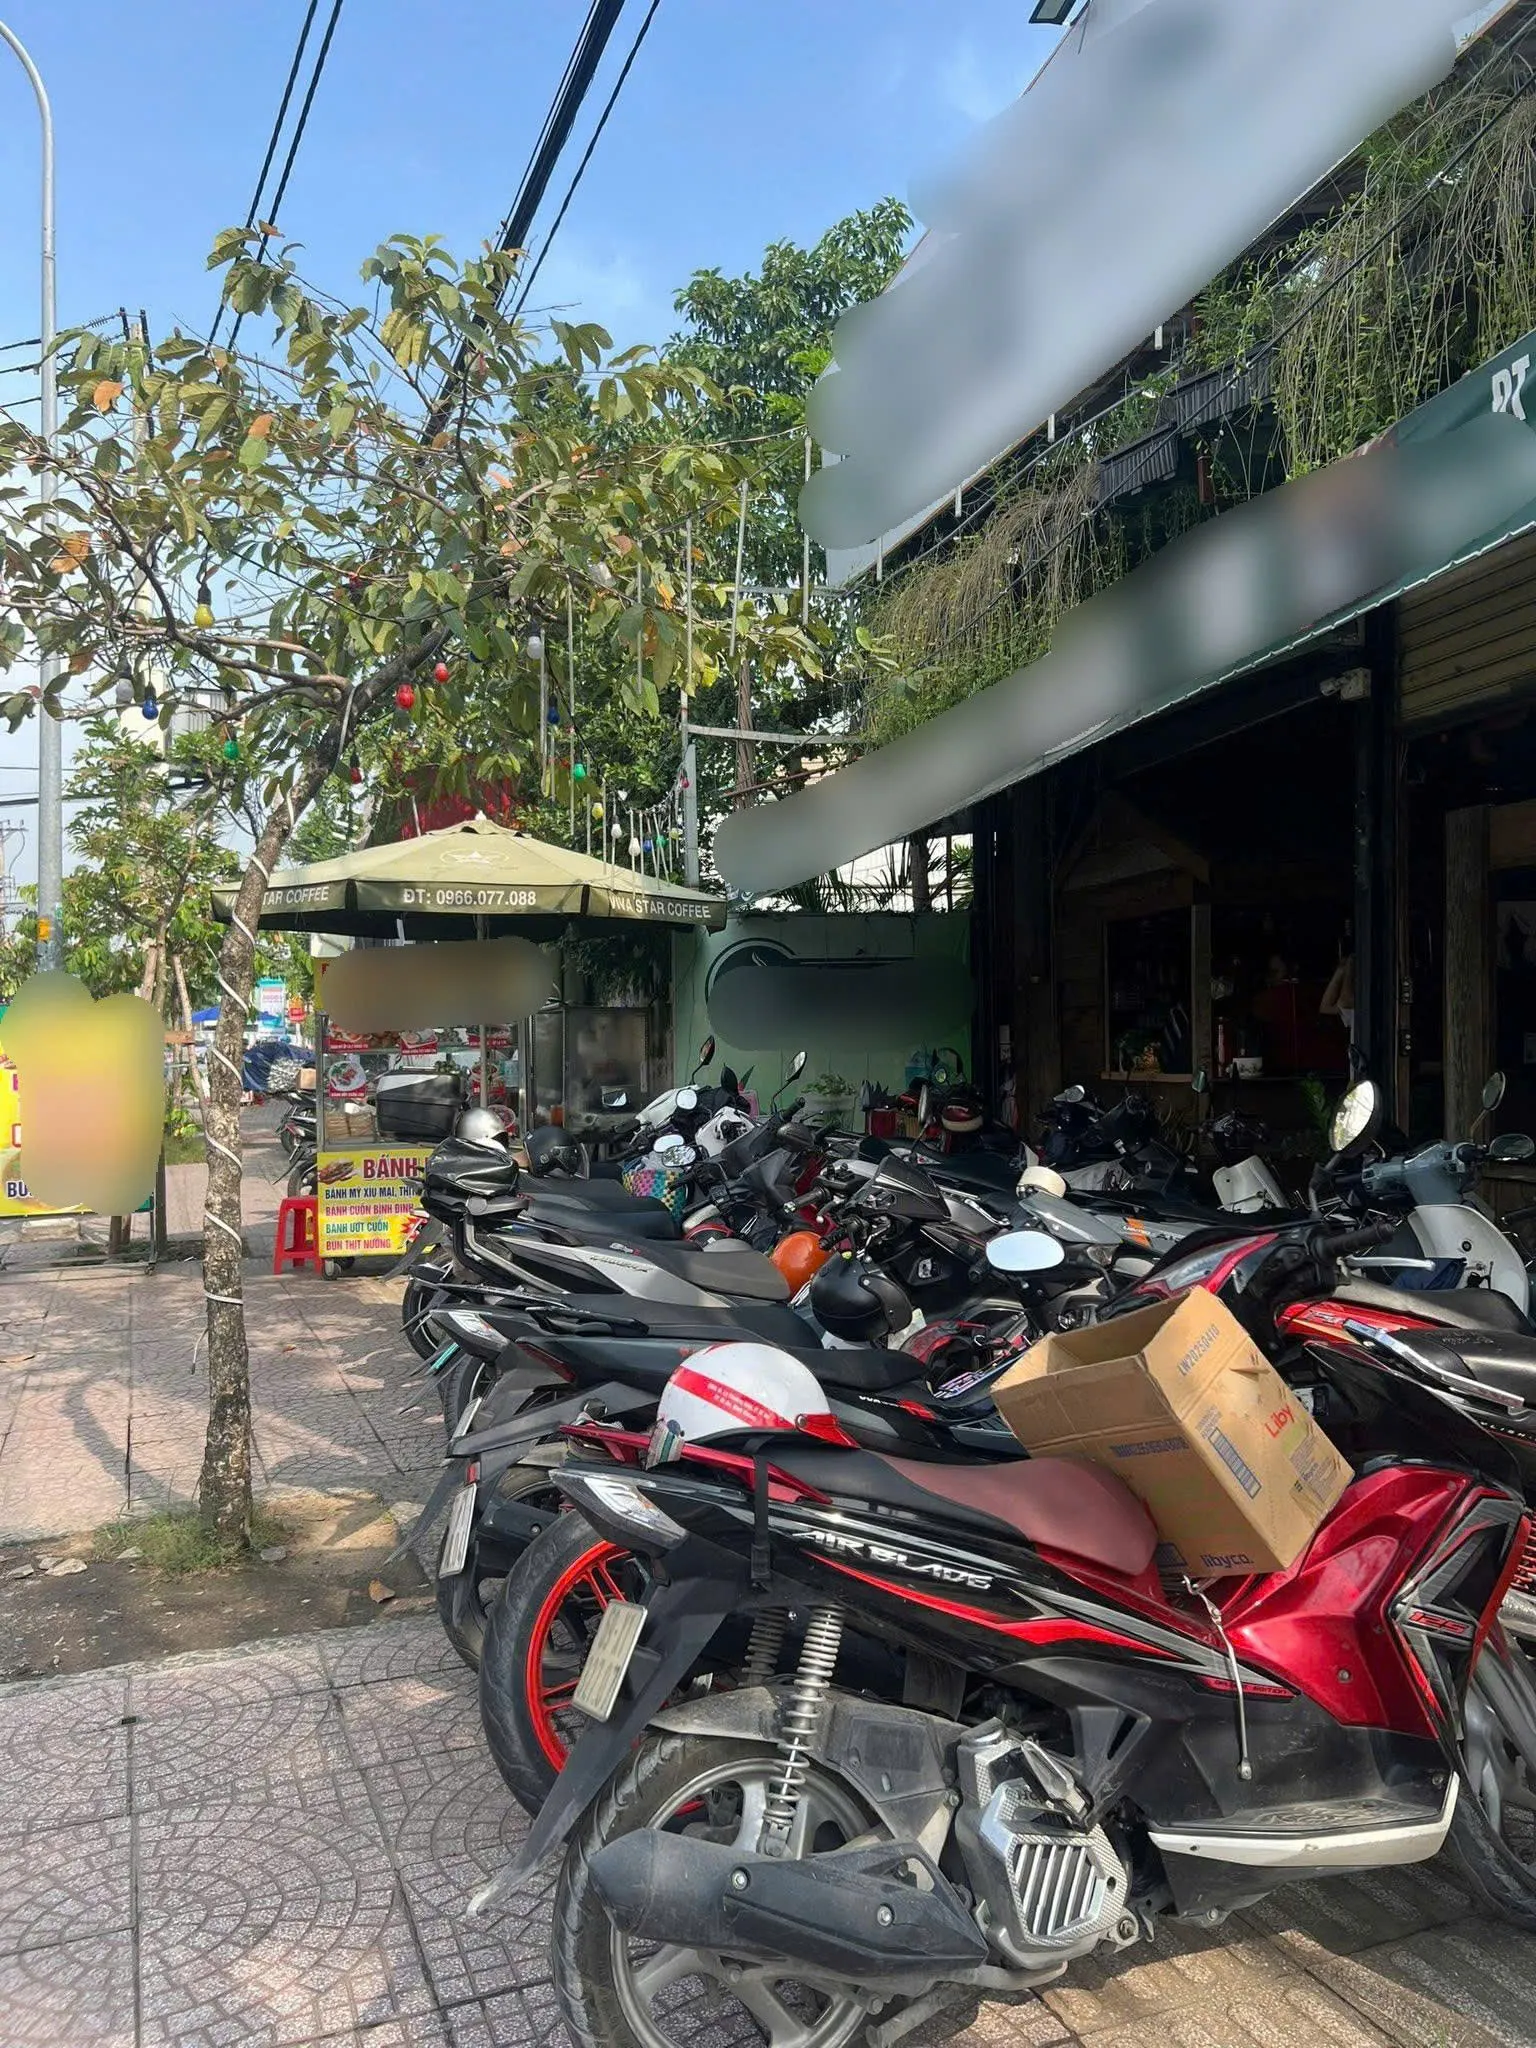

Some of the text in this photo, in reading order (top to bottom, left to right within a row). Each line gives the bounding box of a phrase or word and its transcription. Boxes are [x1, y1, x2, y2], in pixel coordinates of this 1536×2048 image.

[286, 886, 330, 905] COFFEE
[403, 888, 537, 906] ĐT: 0966.077.088
[635, 899, 665, 915] STAR
[667, 902, 712, 919] COFFEE
[363, 1154, 417, 1179] BÁNH
[326, 1186, 347, 1199] BÁNH
[1264, 1404, 1295, 1439] Liby
[1408, 1611, 1469, 1635] 125
